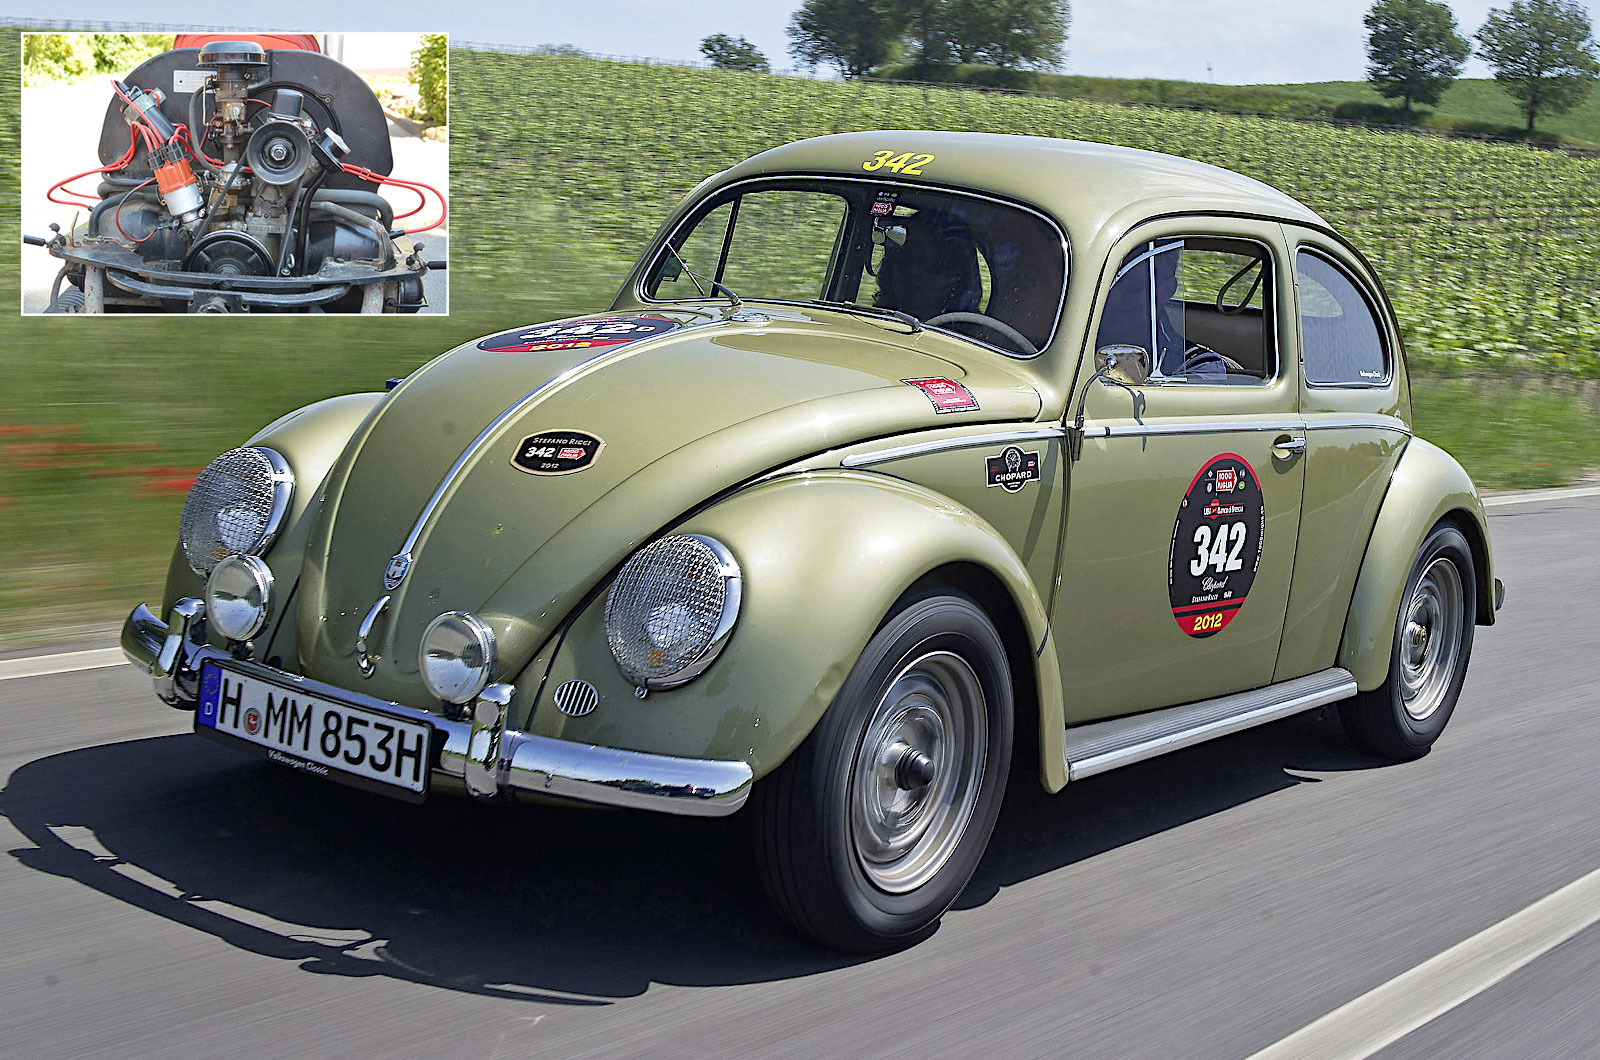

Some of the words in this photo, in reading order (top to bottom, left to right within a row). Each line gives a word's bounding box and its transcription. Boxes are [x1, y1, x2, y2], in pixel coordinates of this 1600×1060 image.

[862, 150, 935, 176] 342
[519, 323, 638, 339] 342
[529, 341, 593, 351] 2012
[532, 437, 568, 445] STEFANO
[568, 438, 592, 446] RICCI
[525, 446, 556, 458] 342
[995, 470, 1033, 482] CHOPARD
[1218, 472, 1232, 480] 1000
[1190, 521, 1247, 577] 342
[1193, 612, 1223, 631] 2012
[204, 701, 214, 717] D
[220, 678, 243, 729] H
[264, 692, 313, 751] MM
[320, 710, 424, 783] 853H
